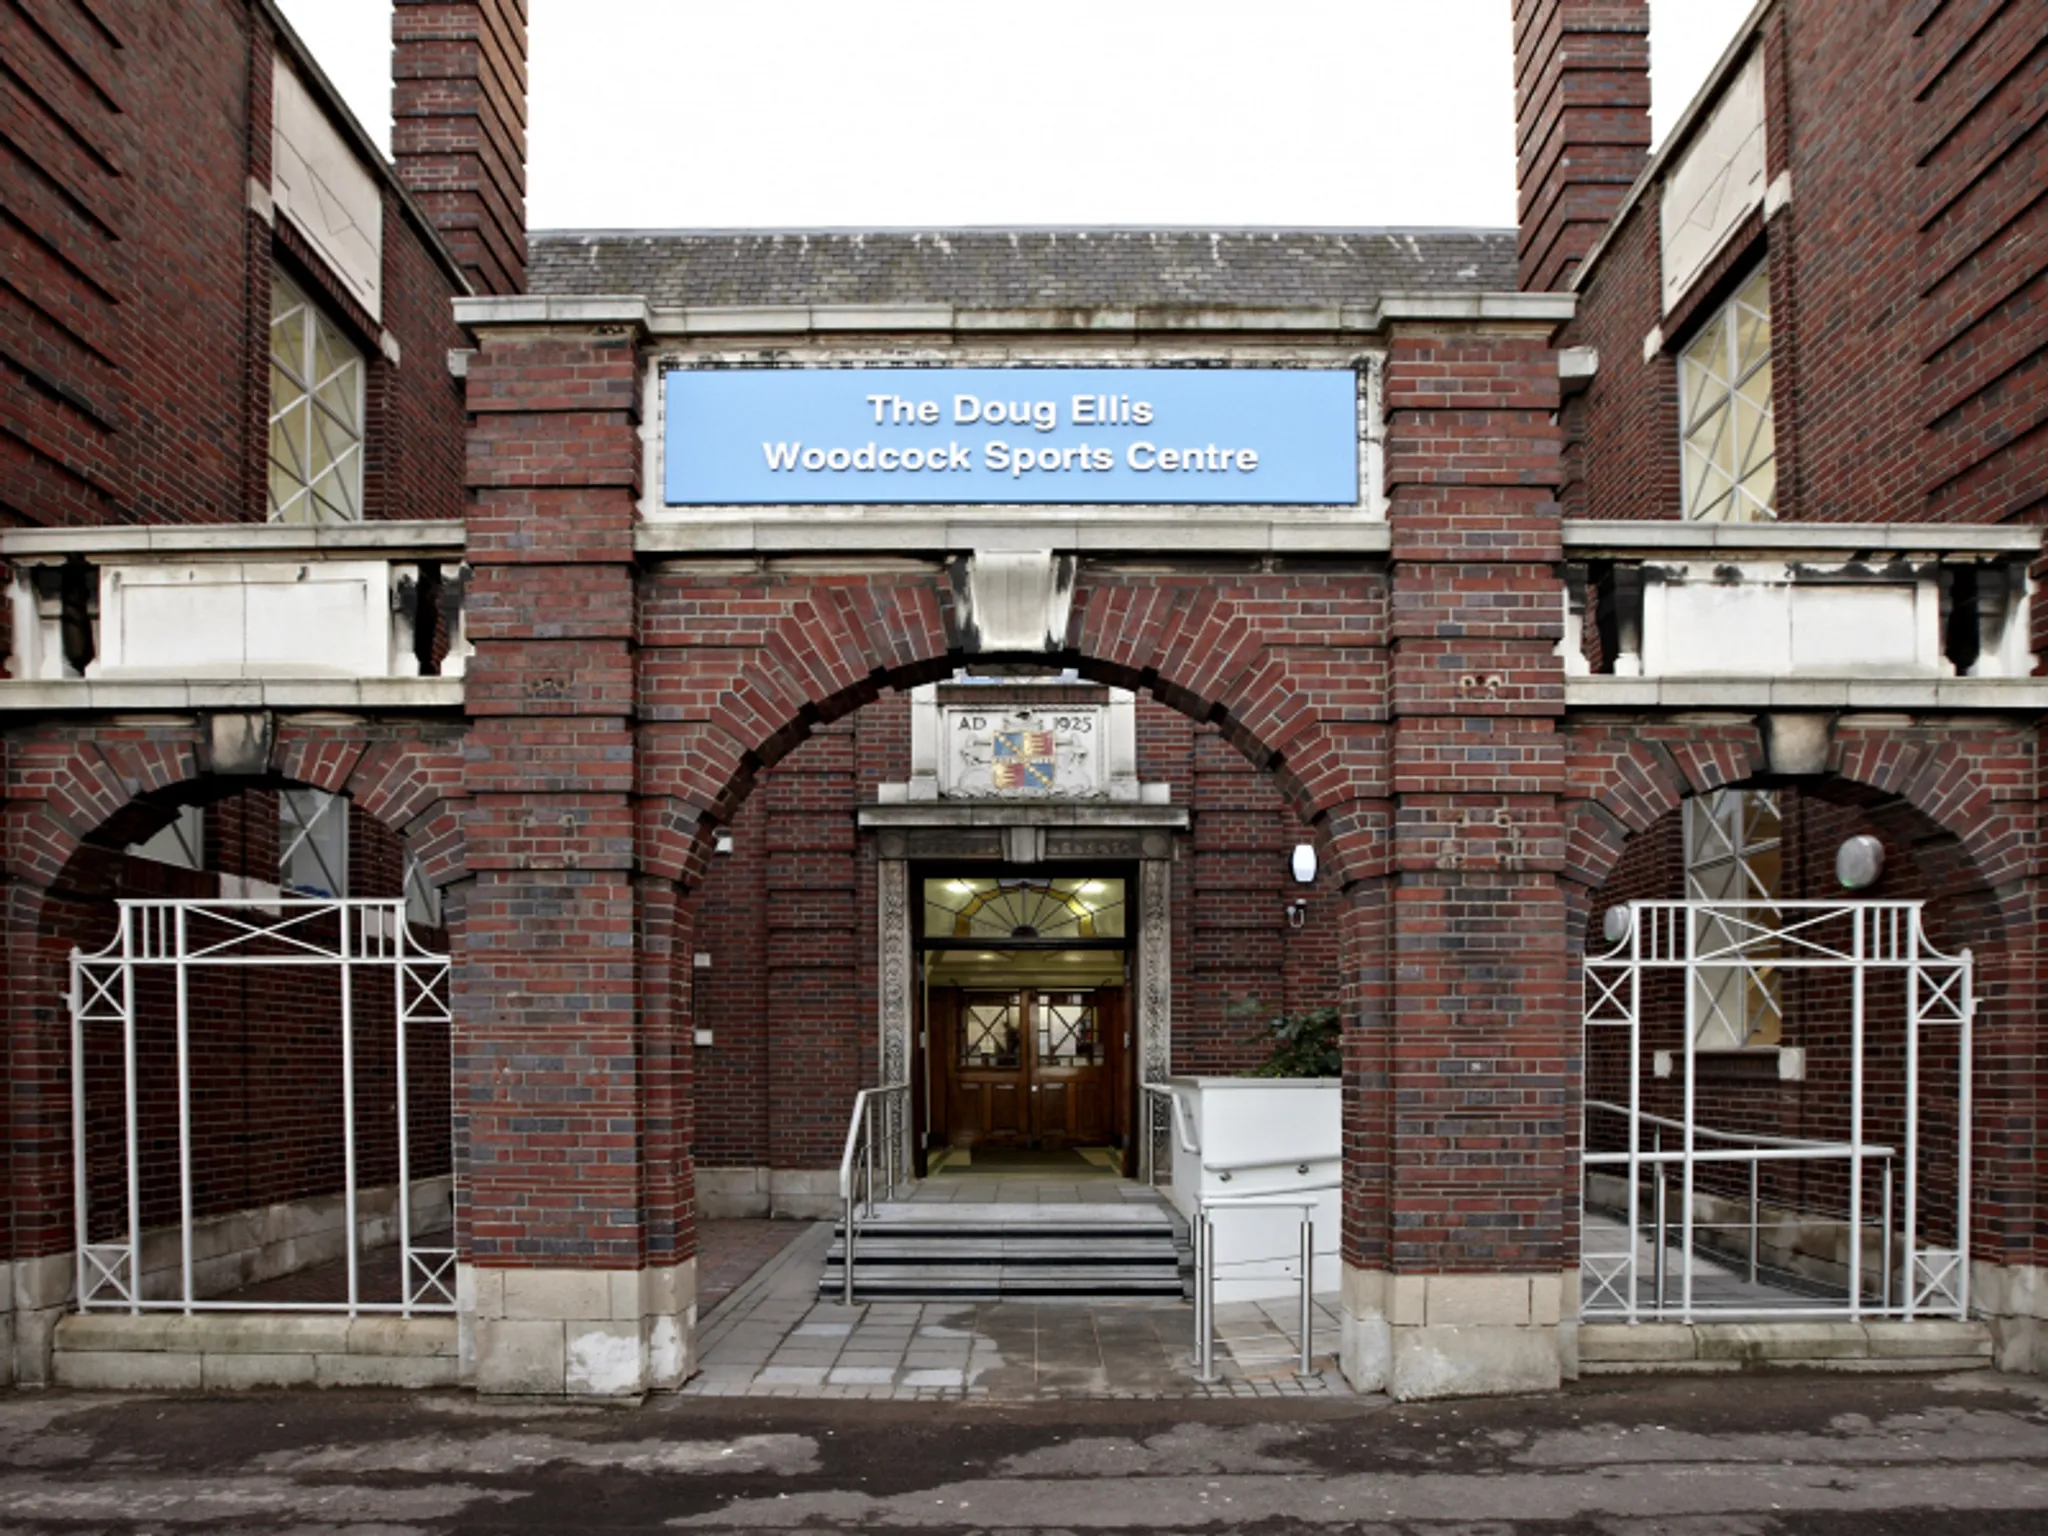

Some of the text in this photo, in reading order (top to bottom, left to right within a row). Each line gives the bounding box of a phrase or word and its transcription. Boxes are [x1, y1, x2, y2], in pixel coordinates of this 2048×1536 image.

[867, 393, 1154, 431] The Doug Ellis
[762, 440, 1258, 478] Woodcock Sports Centre
[957, 717, 1093, 733] AD 1925
